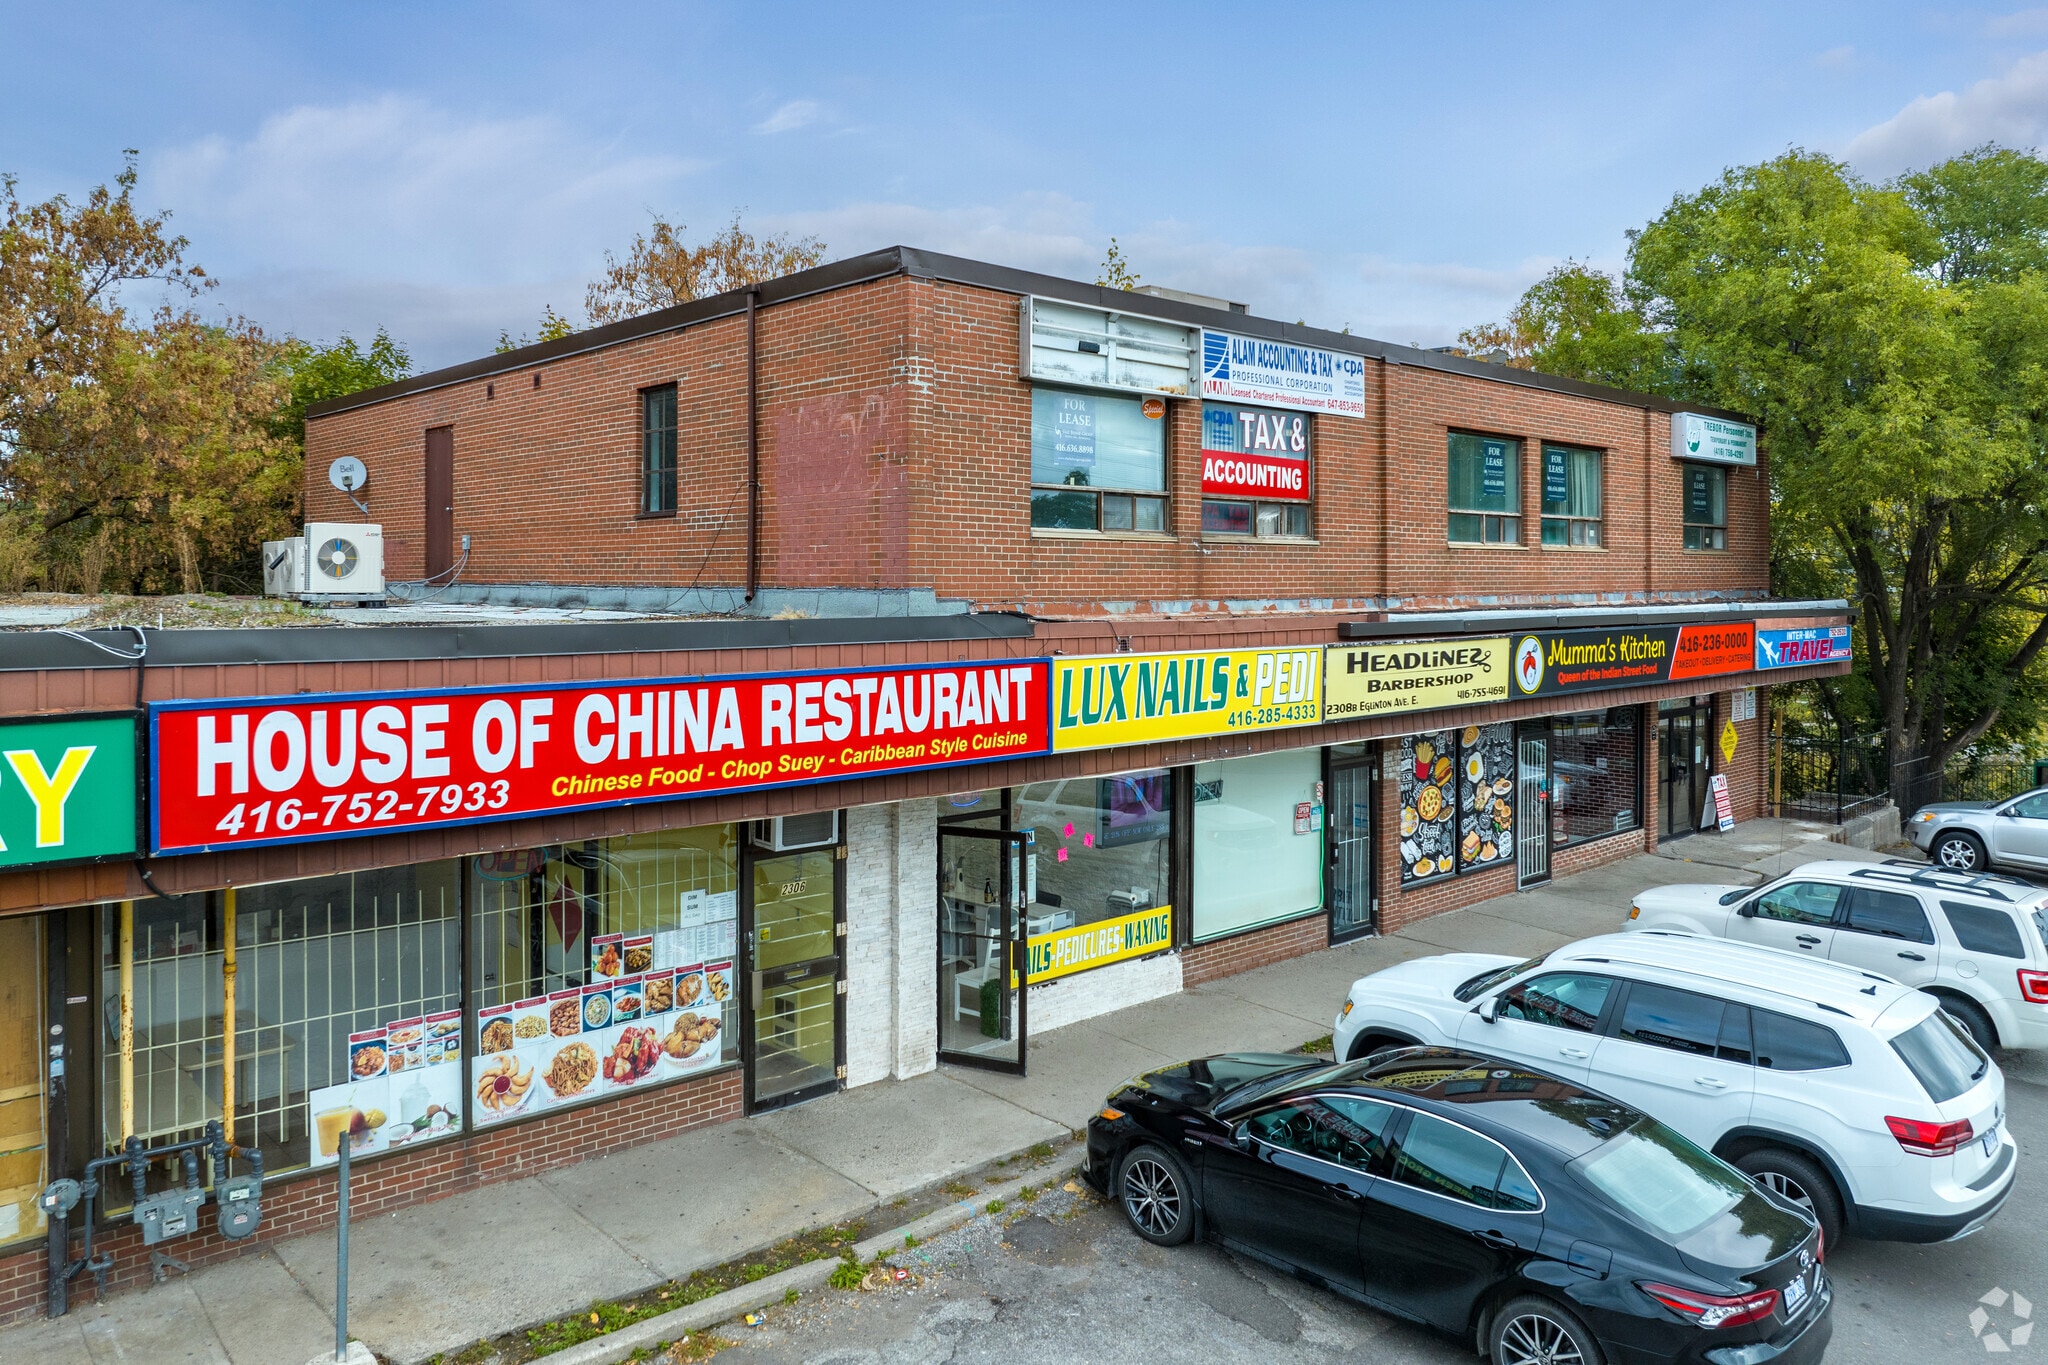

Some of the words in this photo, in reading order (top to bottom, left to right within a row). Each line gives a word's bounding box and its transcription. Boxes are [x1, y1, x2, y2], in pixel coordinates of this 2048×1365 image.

[1232, 338, 1255, 366] ALAM
[1258, 343, 1309, 374] ACCOUNTING
[1311, 351, 1317, 376] &
[1318, 353, 1333, 378] TAX
[1233, 370, 1283, 386] PROFESSIONAL
[1286, 378, 1333, 393] CORPORATION
[1064, 398, 1086, 411] FOR
[1231, 387, 1252, 398] Licensed
[1253, 390, 1275, 401] Chartered
[1275, 393, 1301, 404] Professional
[1143, 403, 1163, 414] Special
[1059, 412, 1091, 426] LEASE
[1240, 412, 1287, 451] TAX
[1291, 418, 1305, 452] &
[1704, 421, 1722, 432] TREBOR
[1723, 425, 1745, 438] Personnel
[1488, 447, 1500, 456] FOR
[1551, 455, 1562, 463] FOR
[340, 464, 354, 472] Bell
[1485, 458, 1503, 466] LEASE
[1548, 465, 1565, 473] LEASE
[1203, 458, 1302, 490] ACCOUNTING
[1680, 632, 1747, 653] 416-236-0000
[1786, 630, 1817, 640] INTER-MAC
[1548, 636, 1616, 667] Mumma's
[1620, 634, 1665, 662] Kitchen
[1779, 638, 1834, 663] TRAVEL
[1676, 660, 1699, 668] TAKEOUT
[1702, 656, 1725, 666] DELIVERY
[1728, 653, 1751, 663] CATERING
[1367, 673, 1474, 693] BARBERSHOP
[1558, 671, 1581, 685] Queen
[1582, 669, 1589, 681] of
[1589, 669, 1600, 680] the
[1601, 666, 1622, 679] Indian
[1623, 665, 1642, 677] Street
[1642, 663, 1657, 675] Food
[1059, 664, 1131, 729] LUX
[1135, 656, 1230, 719] NAILS
[1236, 663, 1249, 698] &
[1253, 651, 1319, 707] PEDI
[1457, 685, 1506, 699] 416-755-4691
[1228, 704, 1316, 727] 416-285-4333
[1326, 703, 1357, 715] 2308B
[197, 704, 451, 797] HOUSE
[472, 697, 553, 775] OF
[574, 687, 744, 765] CHINA
[762, 667, 1032, 748] RESTAURANT
[551, 772, 643, 797] Chinese
[648, 764, 702, 787] Food
[722, 758, 773, 784] Chop
[778, 752, 826, 777] Suey
[840, 743, 926, 767] Caribbean
[931, 736, 968, 758] Style
[972, 730, 1028, 749] Cuisine
[216, 779, 510, 836] 416-752-7933
[480, 850, 544, 873] OPEN
[781, 880, 806, 896] 2306
[686, 903, 699, 911] SUM
[1124, 914, 1168, 949] WAXING
